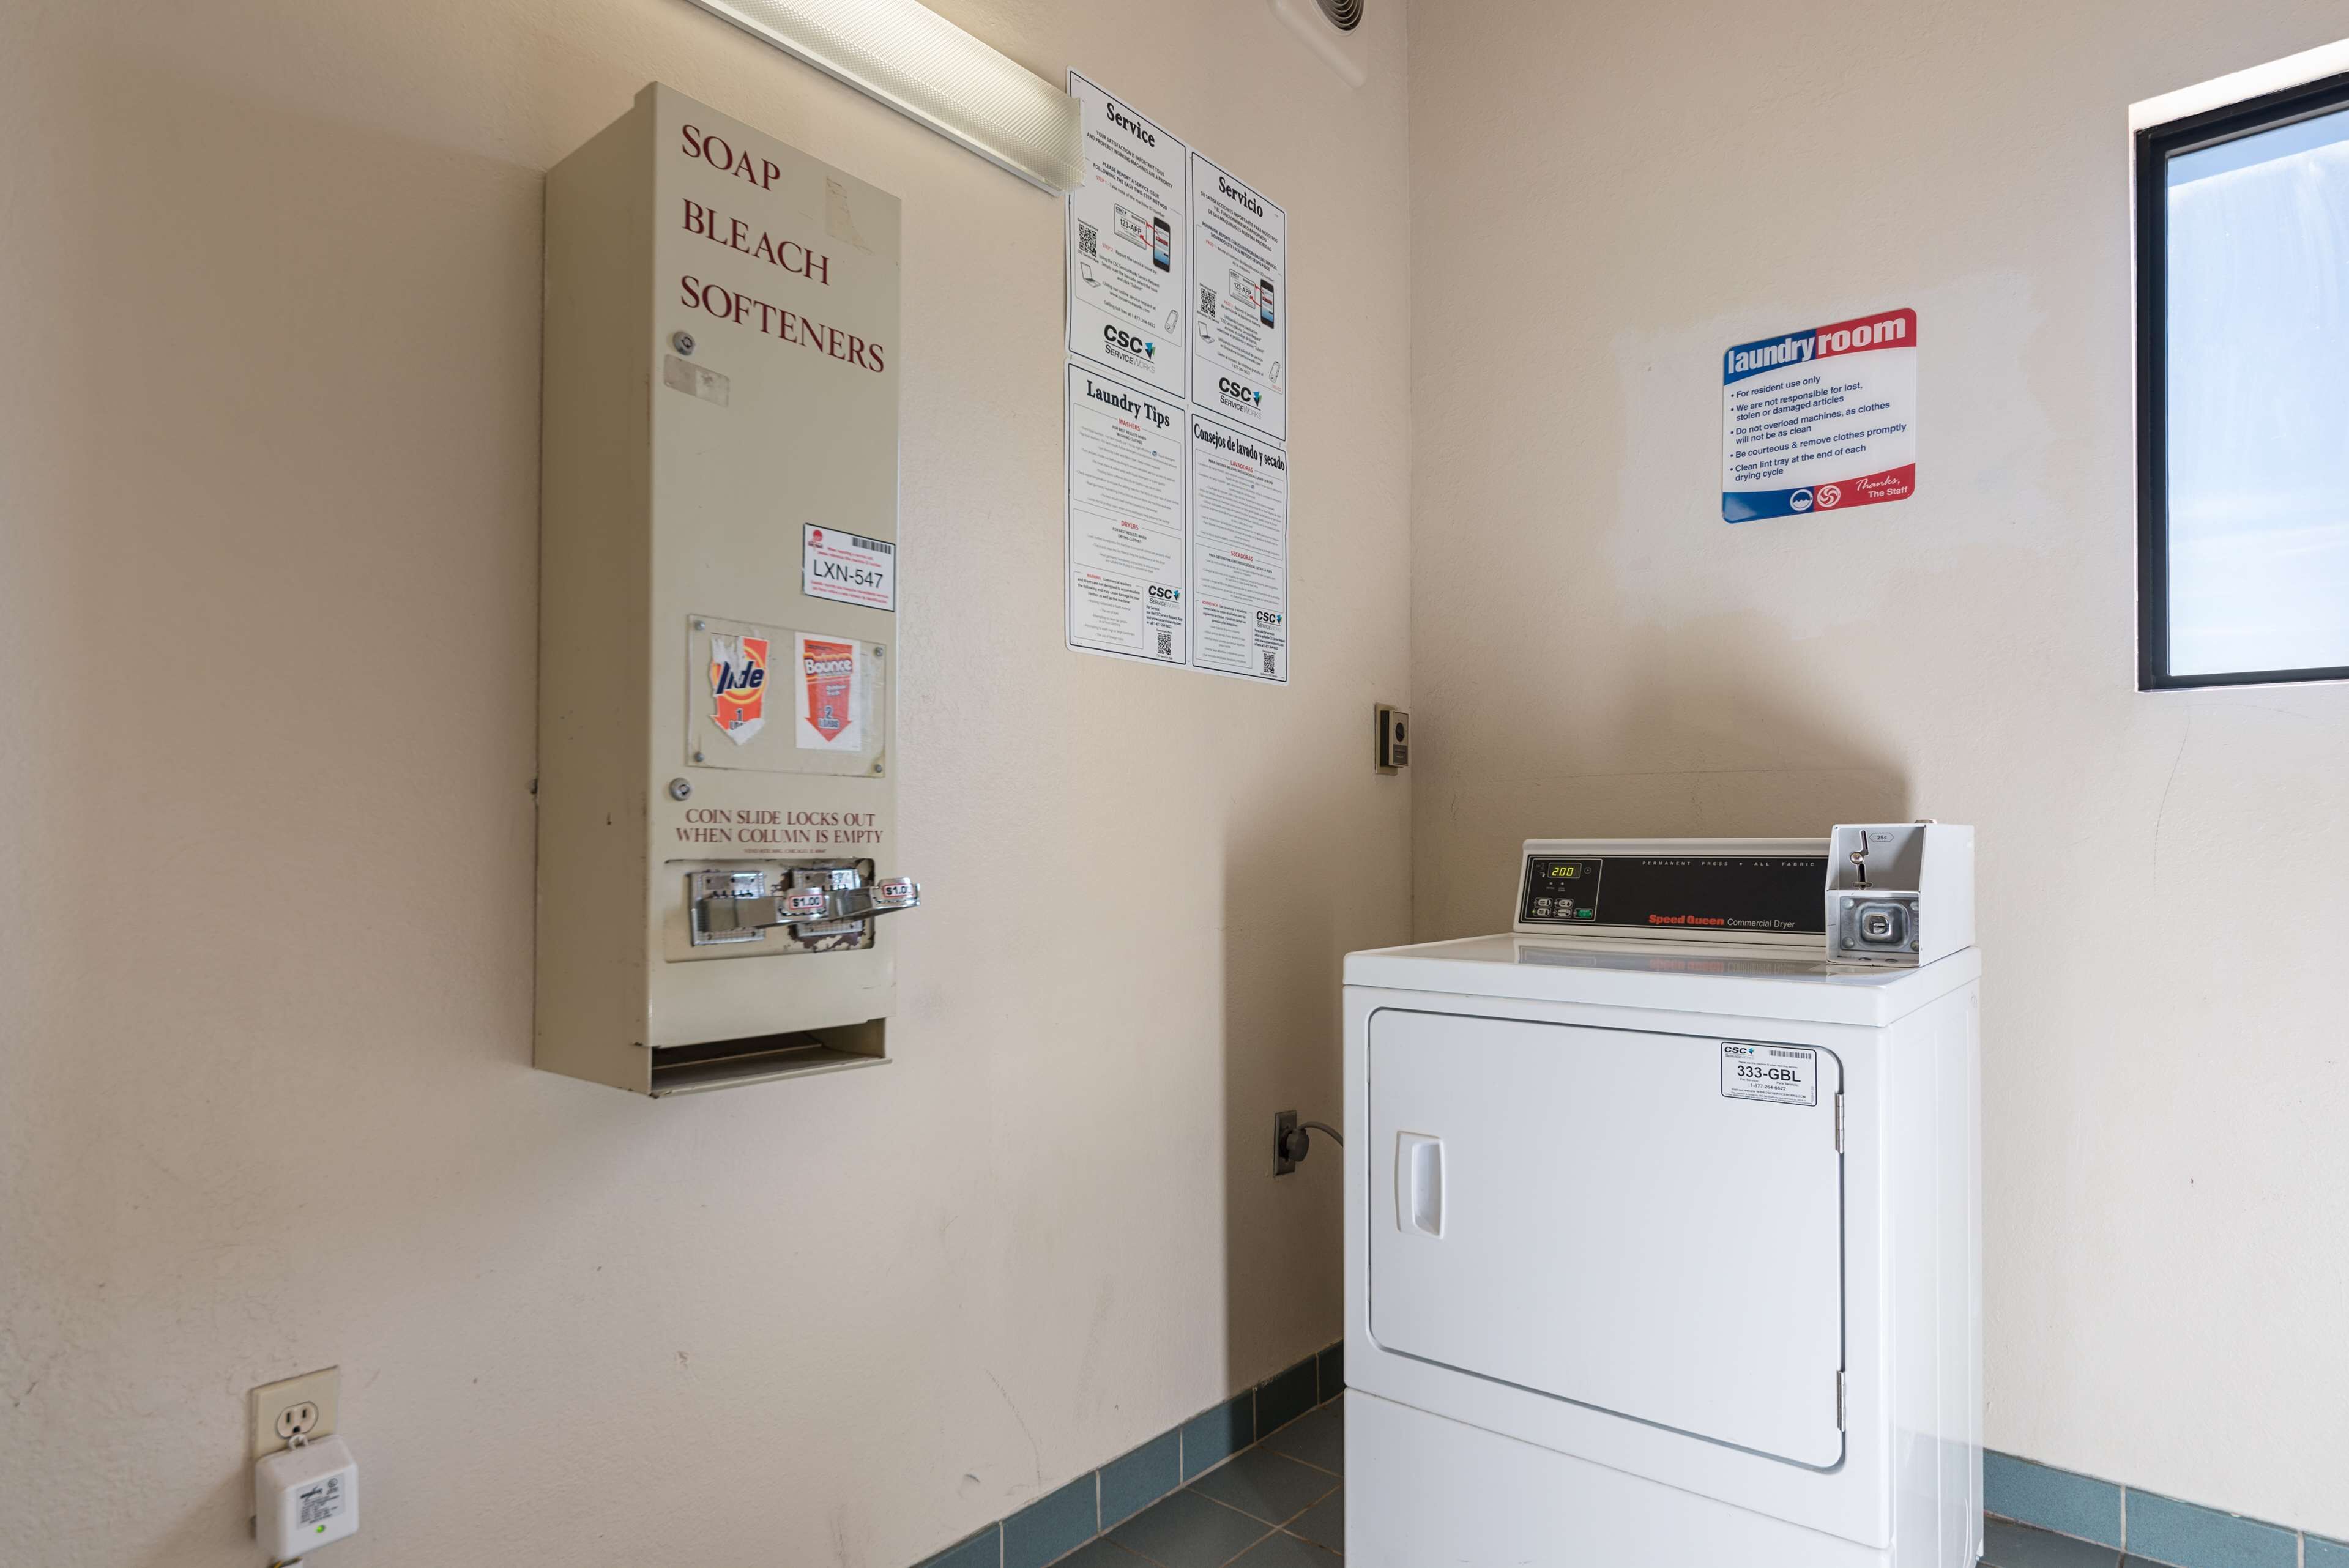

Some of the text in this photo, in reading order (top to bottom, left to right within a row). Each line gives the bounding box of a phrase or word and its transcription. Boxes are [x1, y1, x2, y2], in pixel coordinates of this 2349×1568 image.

[1107, 103, 1155, 147] Service
[682, 124, 780, 191] SOAP
[1096, 130, 1106, 141] YOUR
[1106, 136, 1131, 157] SATISFACTION
[1135, 154, 1154, 171] IMPORTANT
[1087, 132, 1095, 142] AND
[1096, 137, 1113, 153] PROPERLY
[1114, 148, 1130, 163] WORKING
[1131, 158, 1148, 174] MACHINES
[1158, 176, 1172, 189] PRIORITY
[1093, 162, 1115, 180] FOLLOWING
[1124, 180, 1133, 191] EASY
[1134, 186, 1150, 201] TWO-STEP
[1152, 197, 1167, 211] METHOD
[1102, 160, 1115, 174] PLEASE
[1116, 169, 1130, 182] REPORT
[1134, 179, 1148, 193] SERVICE
[1149, 188, 1159, 199] ISSUE
[1219, 177, 1263, 217] Servicio
[1120, 217, 1141, 236] 123-APP
[682, 198, 830, 286] BLEACH
[1234, 281, 1252, 297] 123-APP
[681, 275, 884, 373] SOFTENERS
[1104, 325, 1142, 353] CSC
[1726, 318, 1905, 373] laundry room
[1105, 343, 1155, 374] SERVICEWORKS
[1219, 377, 1251, 401] CSC
[1752, 383, 1783, 395] resident
[1803, 376, 1820, 385] only
[1780, 389, 1828, 403] responsible
[1845, 382, 1862, 391] lost,
[1087, 380, 1169, 428] Laundry Tips
[1737, 412, 1760, 421] stolen
[1773, 401, 1811, 414] damaged
[1813, 396, 1844, 406] articles
[1119, 418, 1140, 431] WASHERS
[1764, 417, 1798, 429] overload
[1801, 411, 1843, 423] machines,
[1858, 403, 1890, 413] clothes
[1194, 423, 1286, 470] Consejos de lavado y secado
[1748, 444, 1789, 456] courteous
[1800, 437, 1831, 447] remove
[1833, 431, 1864, 441] clothes
[1867, 423, 1906, 437] promptly
[1817, 450, 1832, 458] end
[1845, 445, 1866, 454] each
[1230, 459, 1253, 473] LAVADORAS
[1735, 468, 1783, 481] drying cycle
[1855, 475, 1900, 491] Thanks,
[1887, 486, 1909, 495] Staff
[1121, 520, 1138, 530] DRYERS
[1230, 550, 1253, 562] SECADORAS
[814, 560, 883, 587] LXN-547
[1148, 584, 1172, 600] CSC
[1256, 610, 1275, 623] CSC
[805, 658, 852, 675] Bounce
[736, 708, 743, 721] 1
[825, 705, 832, 719] 2
[686, 809, 875, 826] COIN SLIDE LOCKS OUT
[676, 828, 882, 843] WHEN COLUMN IS EMPTY
[1552, 868, 1574, 876] 200
[792, 897, 819, 907] $1.00
[1649, 915, 1795, 929] Speed Queen Commercial Dryer
[1738, 1066, 1801, 1082] 333-GBL
